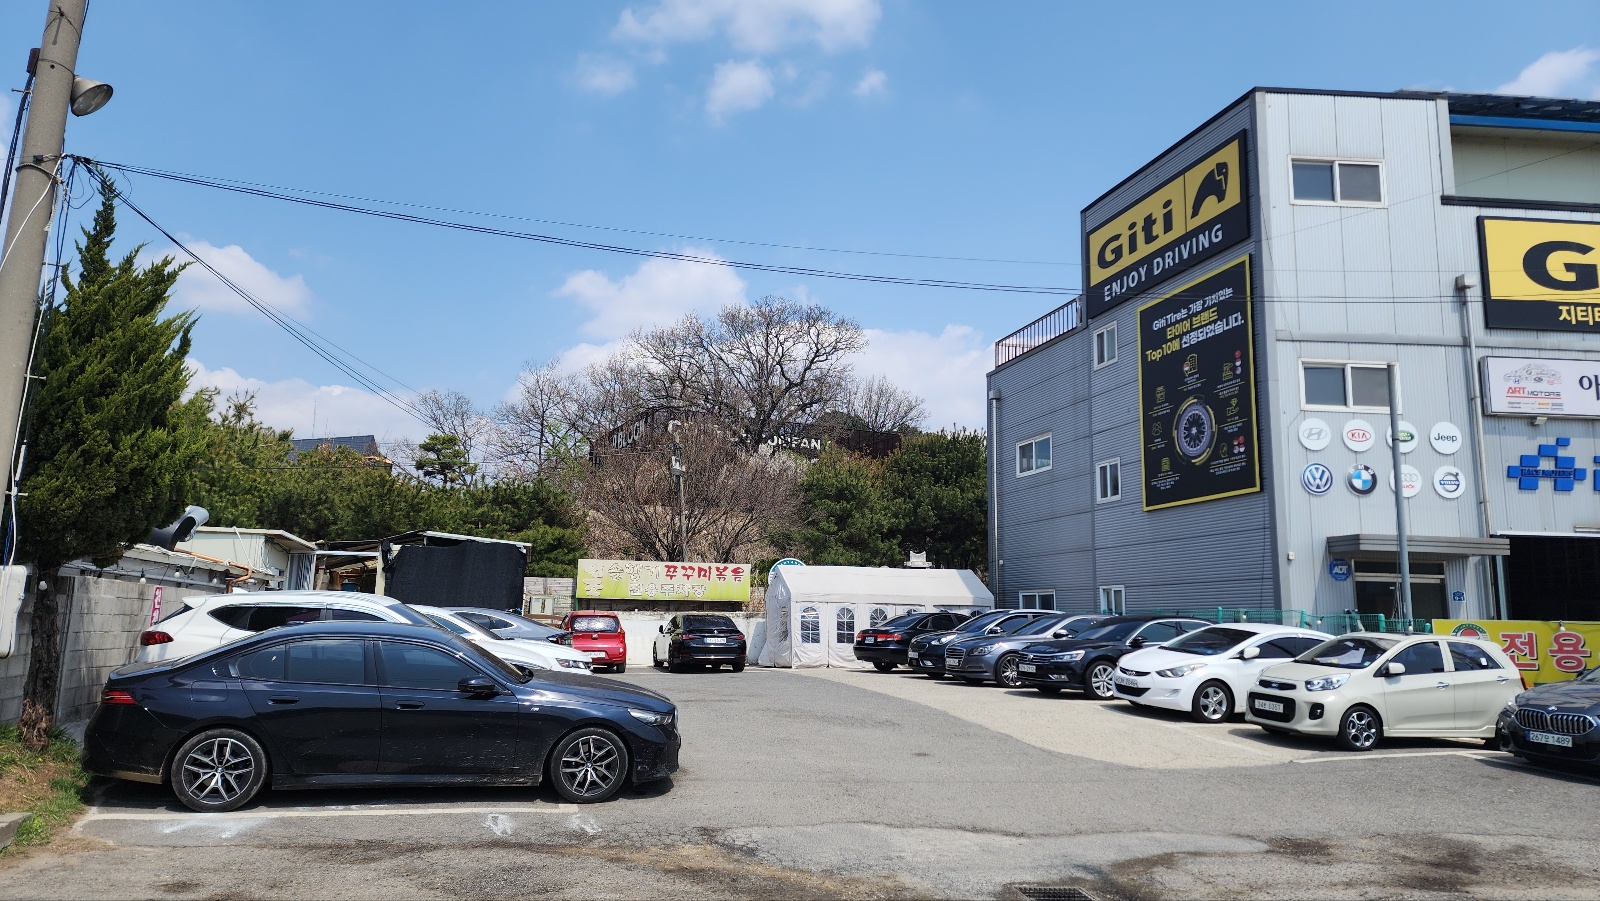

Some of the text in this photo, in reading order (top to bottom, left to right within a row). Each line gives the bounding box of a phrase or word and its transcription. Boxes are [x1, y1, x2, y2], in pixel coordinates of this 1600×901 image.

[1097, 199, 1174, 270] Giti
[1104, 223, 1223, 301] ENJOY DRIVING
[1522, 240, 1600, 291] G
[1189, 299, 1203, 314] 가장
[1166, 307, 1219, 339] 타이어 브랜드
[1181, 312, 1245, 348] 선정되었습니다.
[1506, 386, 1527, 395] ART
[1351, 432, 1368, 440] KIA
[1434, 433, 1458, 443] Jeep
[664, 564, 745, 582] 쭈꾸미볶음
[1332, 565, 1348, 574] ADT
[629, 582, 707, 599] 전용주차장
[1551, 735, 1570, 745] 1489
